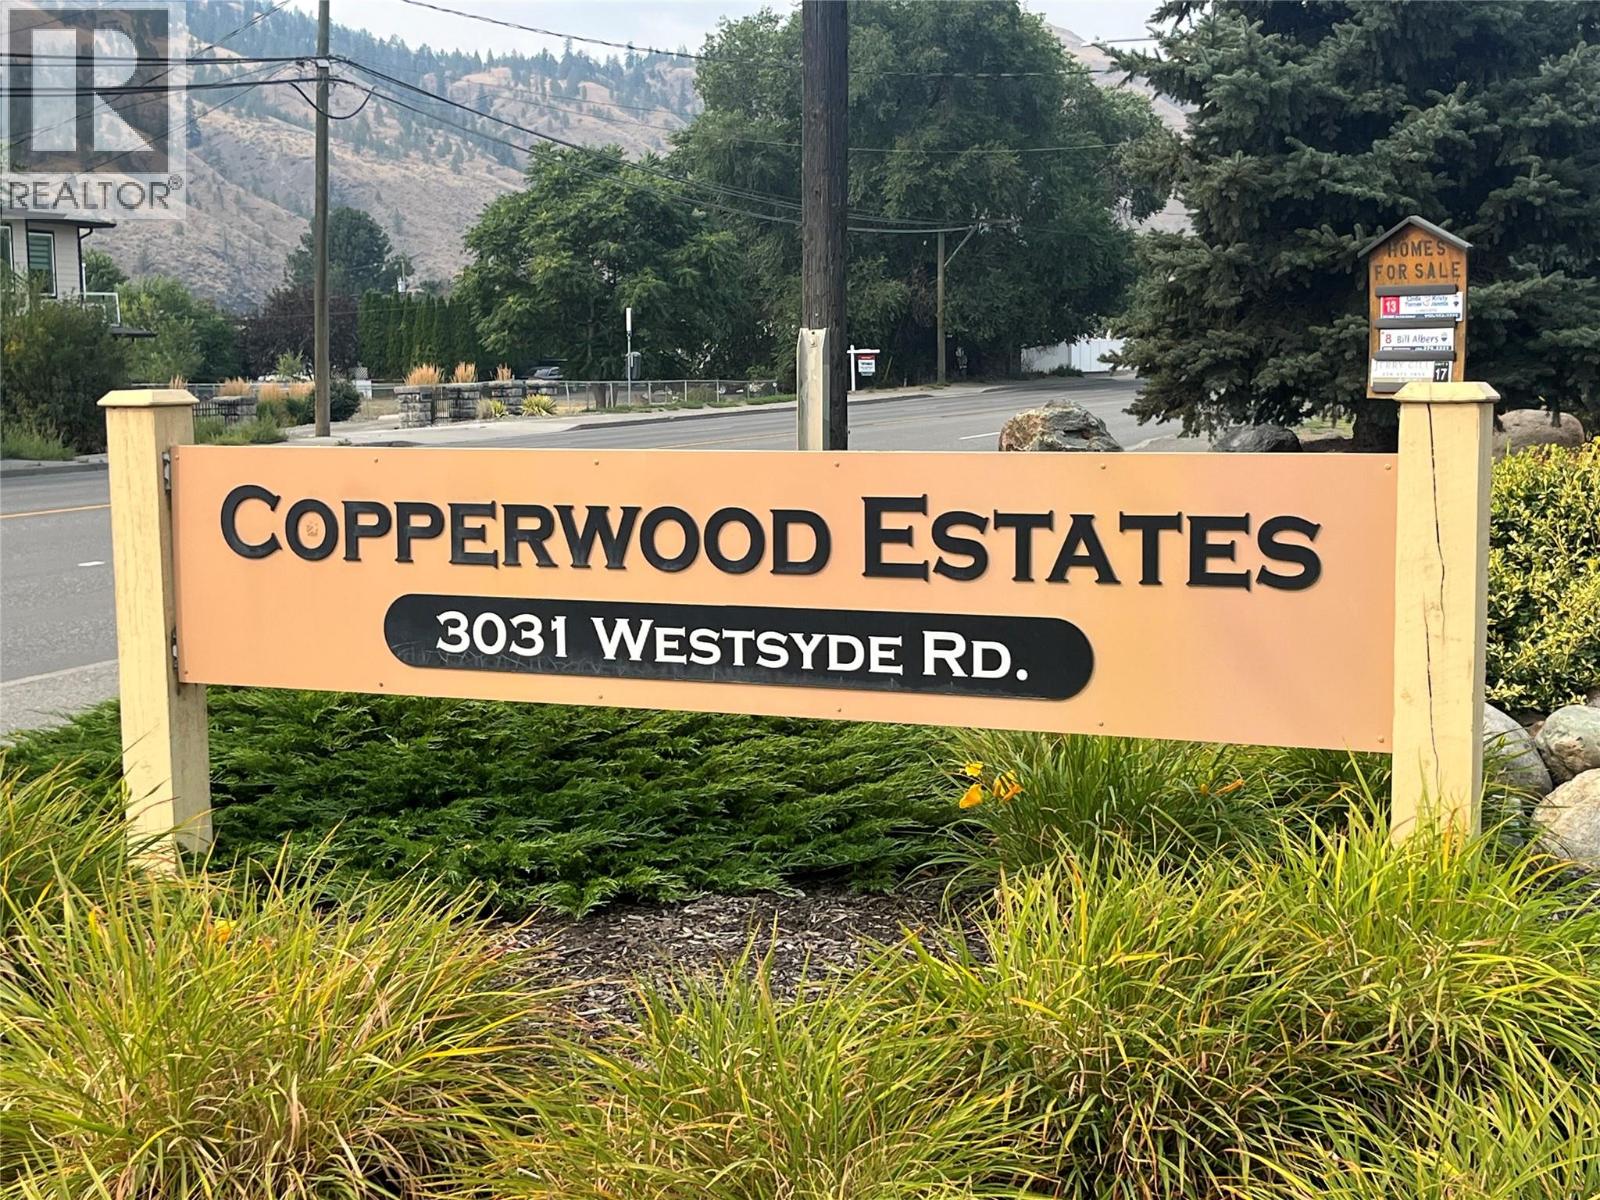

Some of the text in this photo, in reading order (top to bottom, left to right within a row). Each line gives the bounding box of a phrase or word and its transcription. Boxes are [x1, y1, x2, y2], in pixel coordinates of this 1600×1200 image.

[1388, 241, 1446, 257] HOMES
[1375, 262, 1460, 280] FOR SALE
[1385, 301, 1397, 313] 13
[1385, 334, 1439, 344] 8 Bill Albers
[1435, 368, 1448, 381] 17
[220, 484, 1322, 592] COPPERWOOD ESTATES
[436, 610, 1029, 682] 3031 WESTSYDE RD.
